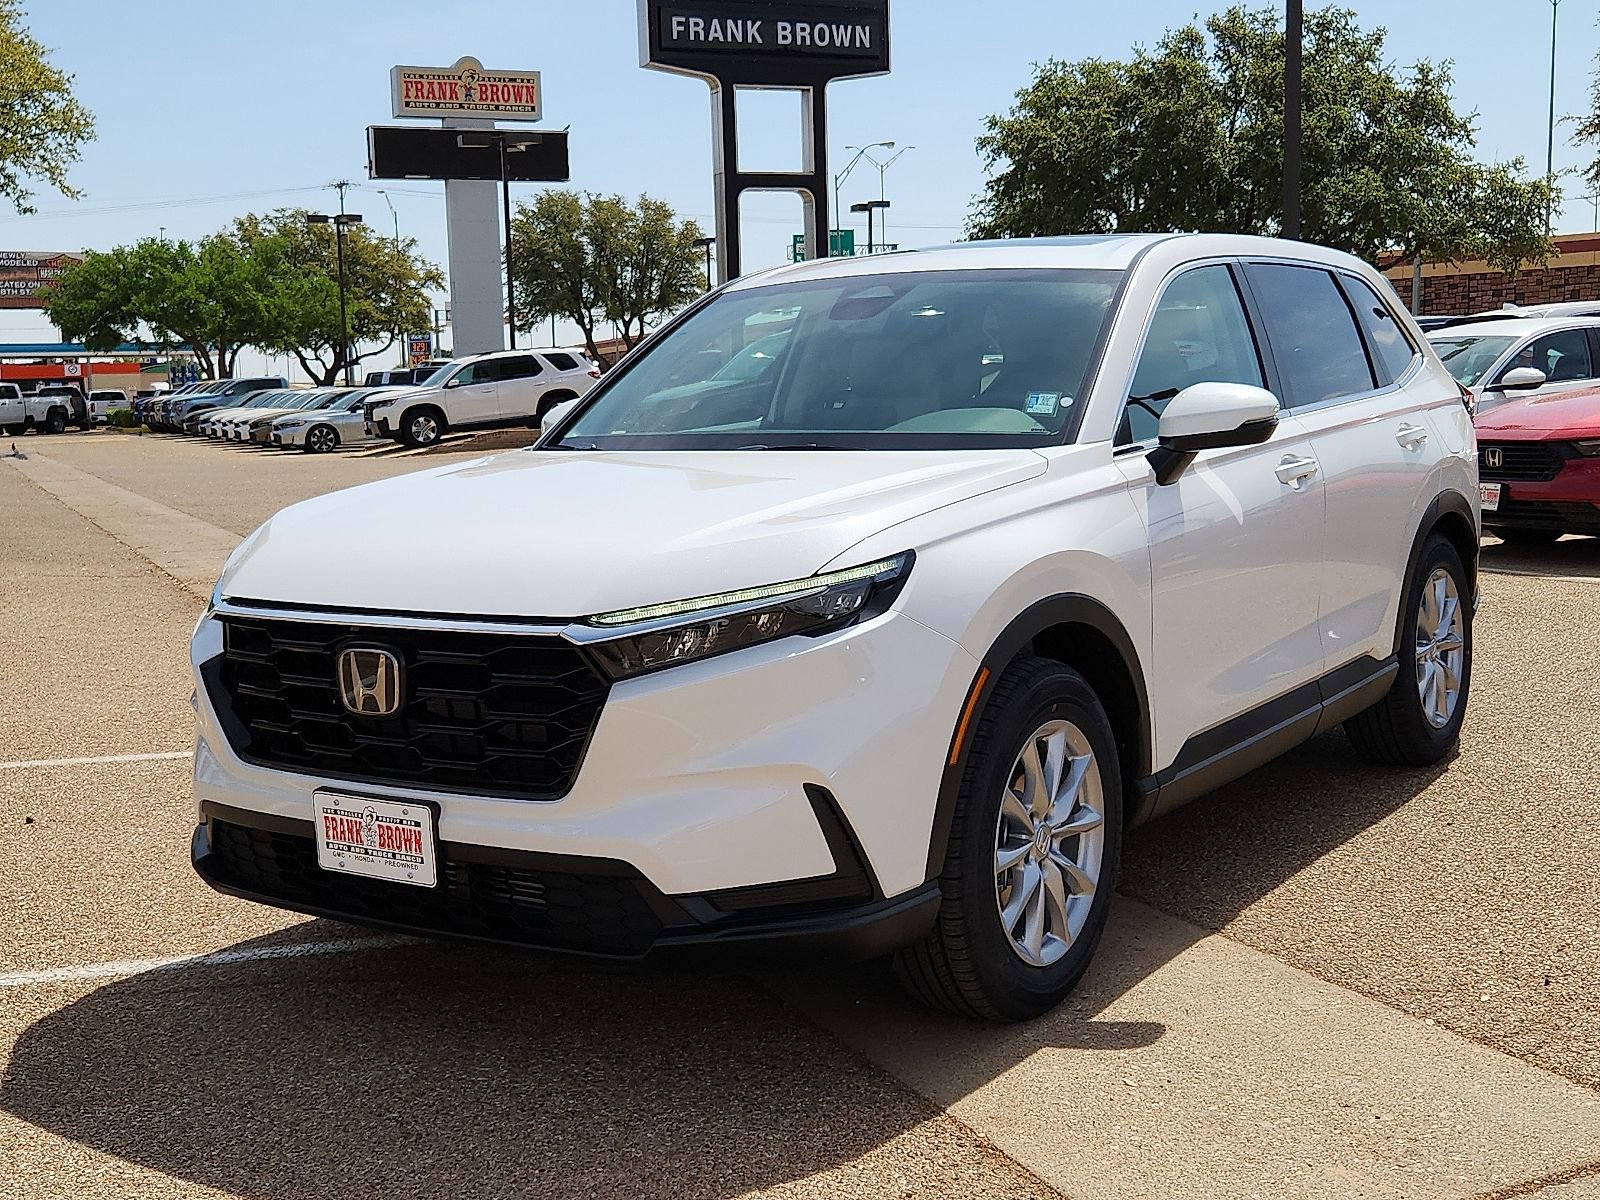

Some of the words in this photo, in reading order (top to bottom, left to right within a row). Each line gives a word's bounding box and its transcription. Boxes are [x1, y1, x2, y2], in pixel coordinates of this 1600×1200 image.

[671, 16, 763, 44] FRANK
[777, 21, 871, 48] BROWN
[404, 80, 459, 101] FRANK
[478, 83, 535, 105] BROWN
[324, 815, 364, 846] FRANK
[378, 823, 423, 855] BROWN
[328, 842, 349, 851] AUTO
[350, 846, 366, 854] AND
[367, 848, 394, 859] TRUCK
[395, 853, 422, 863] RANCH
[354, 855, 375, 864] HONDA
[384, 859, 419, 871] PREOWNED
